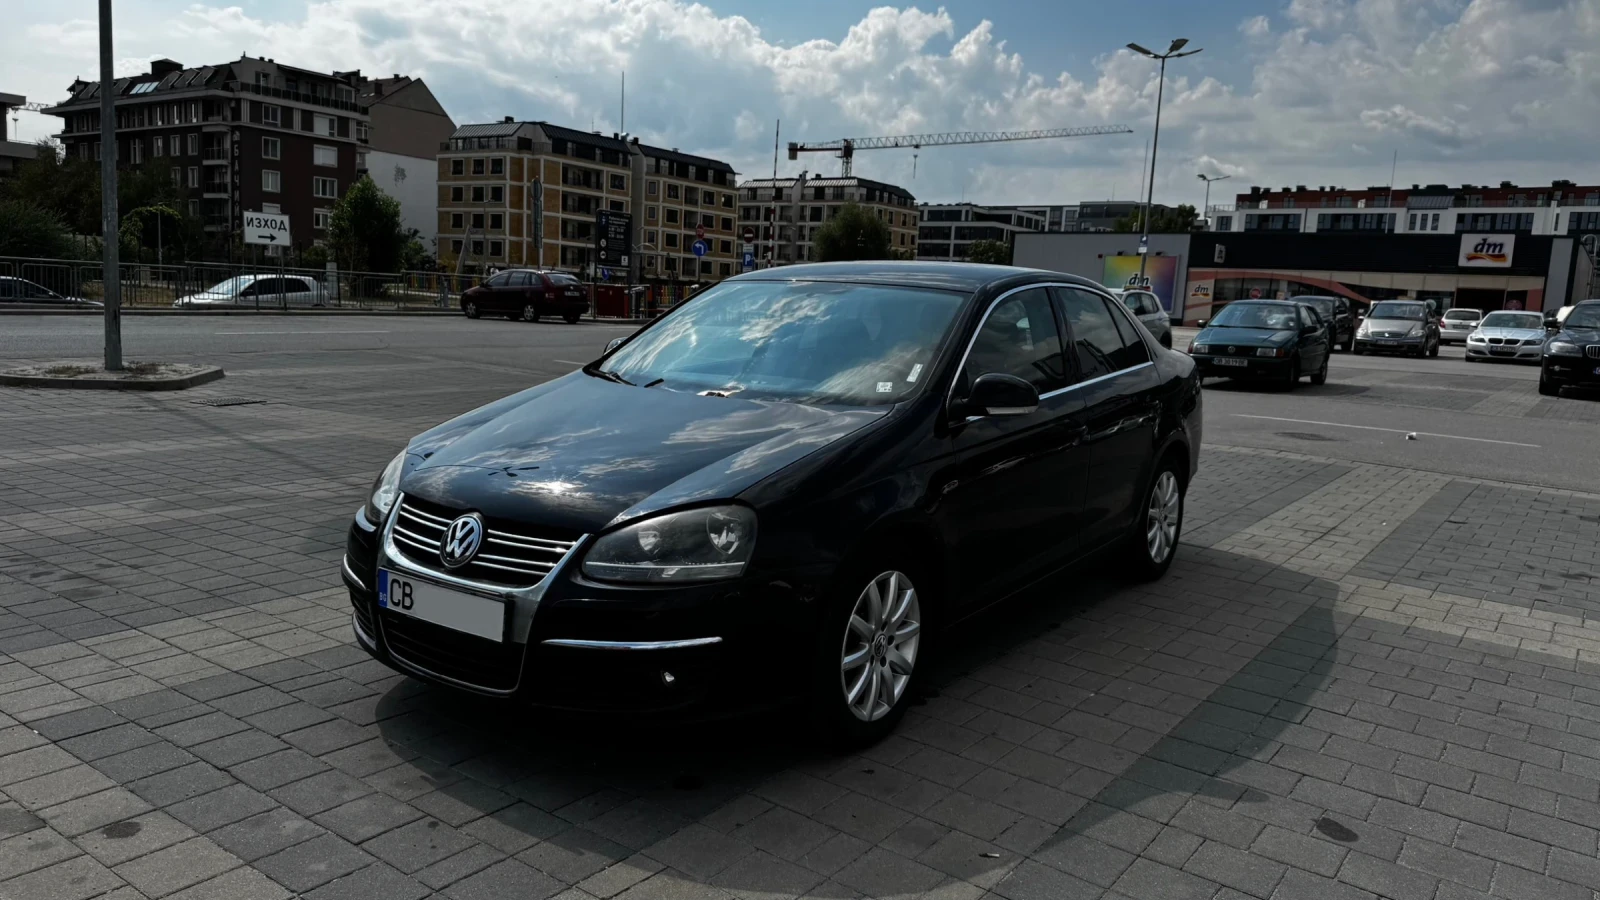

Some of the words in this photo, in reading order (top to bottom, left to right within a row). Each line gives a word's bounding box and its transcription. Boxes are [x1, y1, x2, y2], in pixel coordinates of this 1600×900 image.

[247, 217, 287, 231] ИЗХОД
[1474, 237, 1504, 254] dm
[744, 253, 752, 266] P
[1194, 284, 1209, 293] dm
[379, 592, 387, 602] BG
[390, 578, 414, 610] CB
